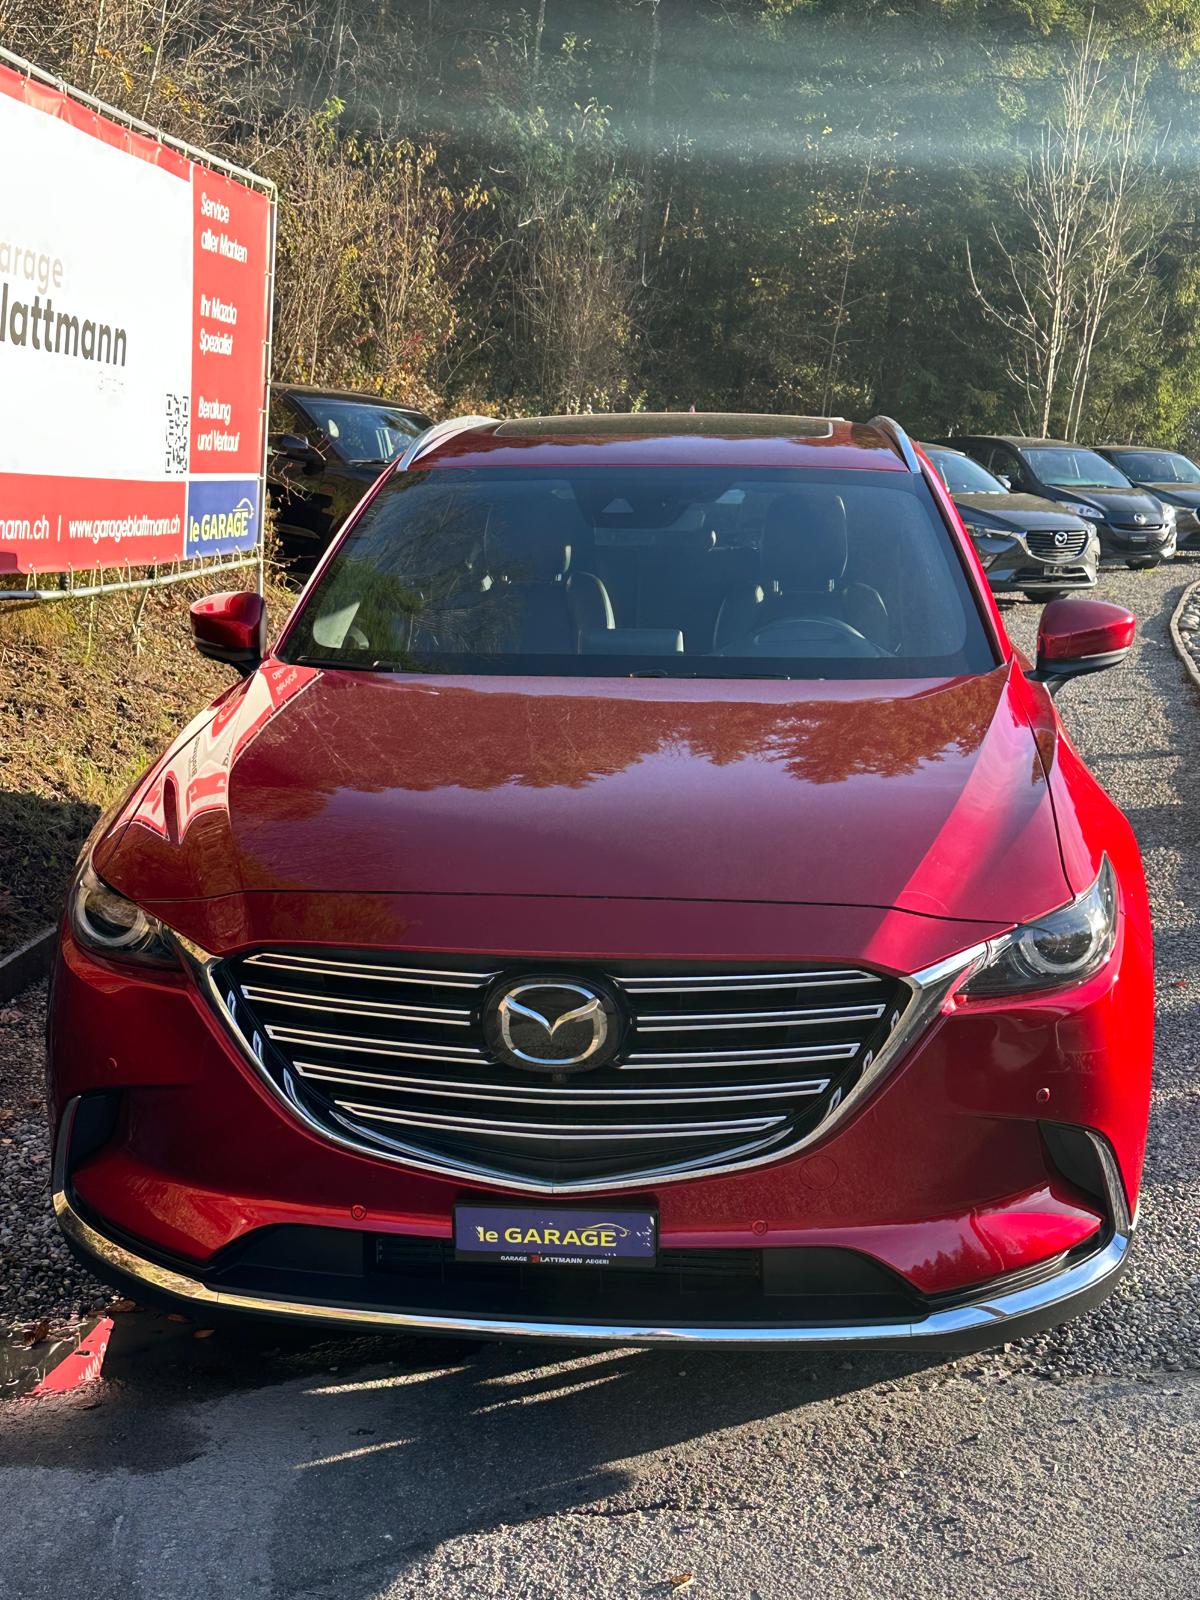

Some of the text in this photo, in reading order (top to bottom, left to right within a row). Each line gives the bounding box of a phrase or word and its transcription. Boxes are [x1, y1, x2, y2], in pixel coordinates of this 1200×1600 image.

[201, 192, 230, 224] Service
[201, 228, 248, 264] aller Marken
[200, 294, 237, 325] Ihr Mazda
[199, 327, 233, 356] Spezialist
[198, 396, 231, 426] Beratung
[197, 429, 241, 453] und Verkauf
[68, 514, 181, 544] www.garageblattmann.ch
[189, 511, 249, 543] le GARAGE
[504, 1228, 617, 1247] GARAGE
[500, 1255, 528, 1263] GARAGE
